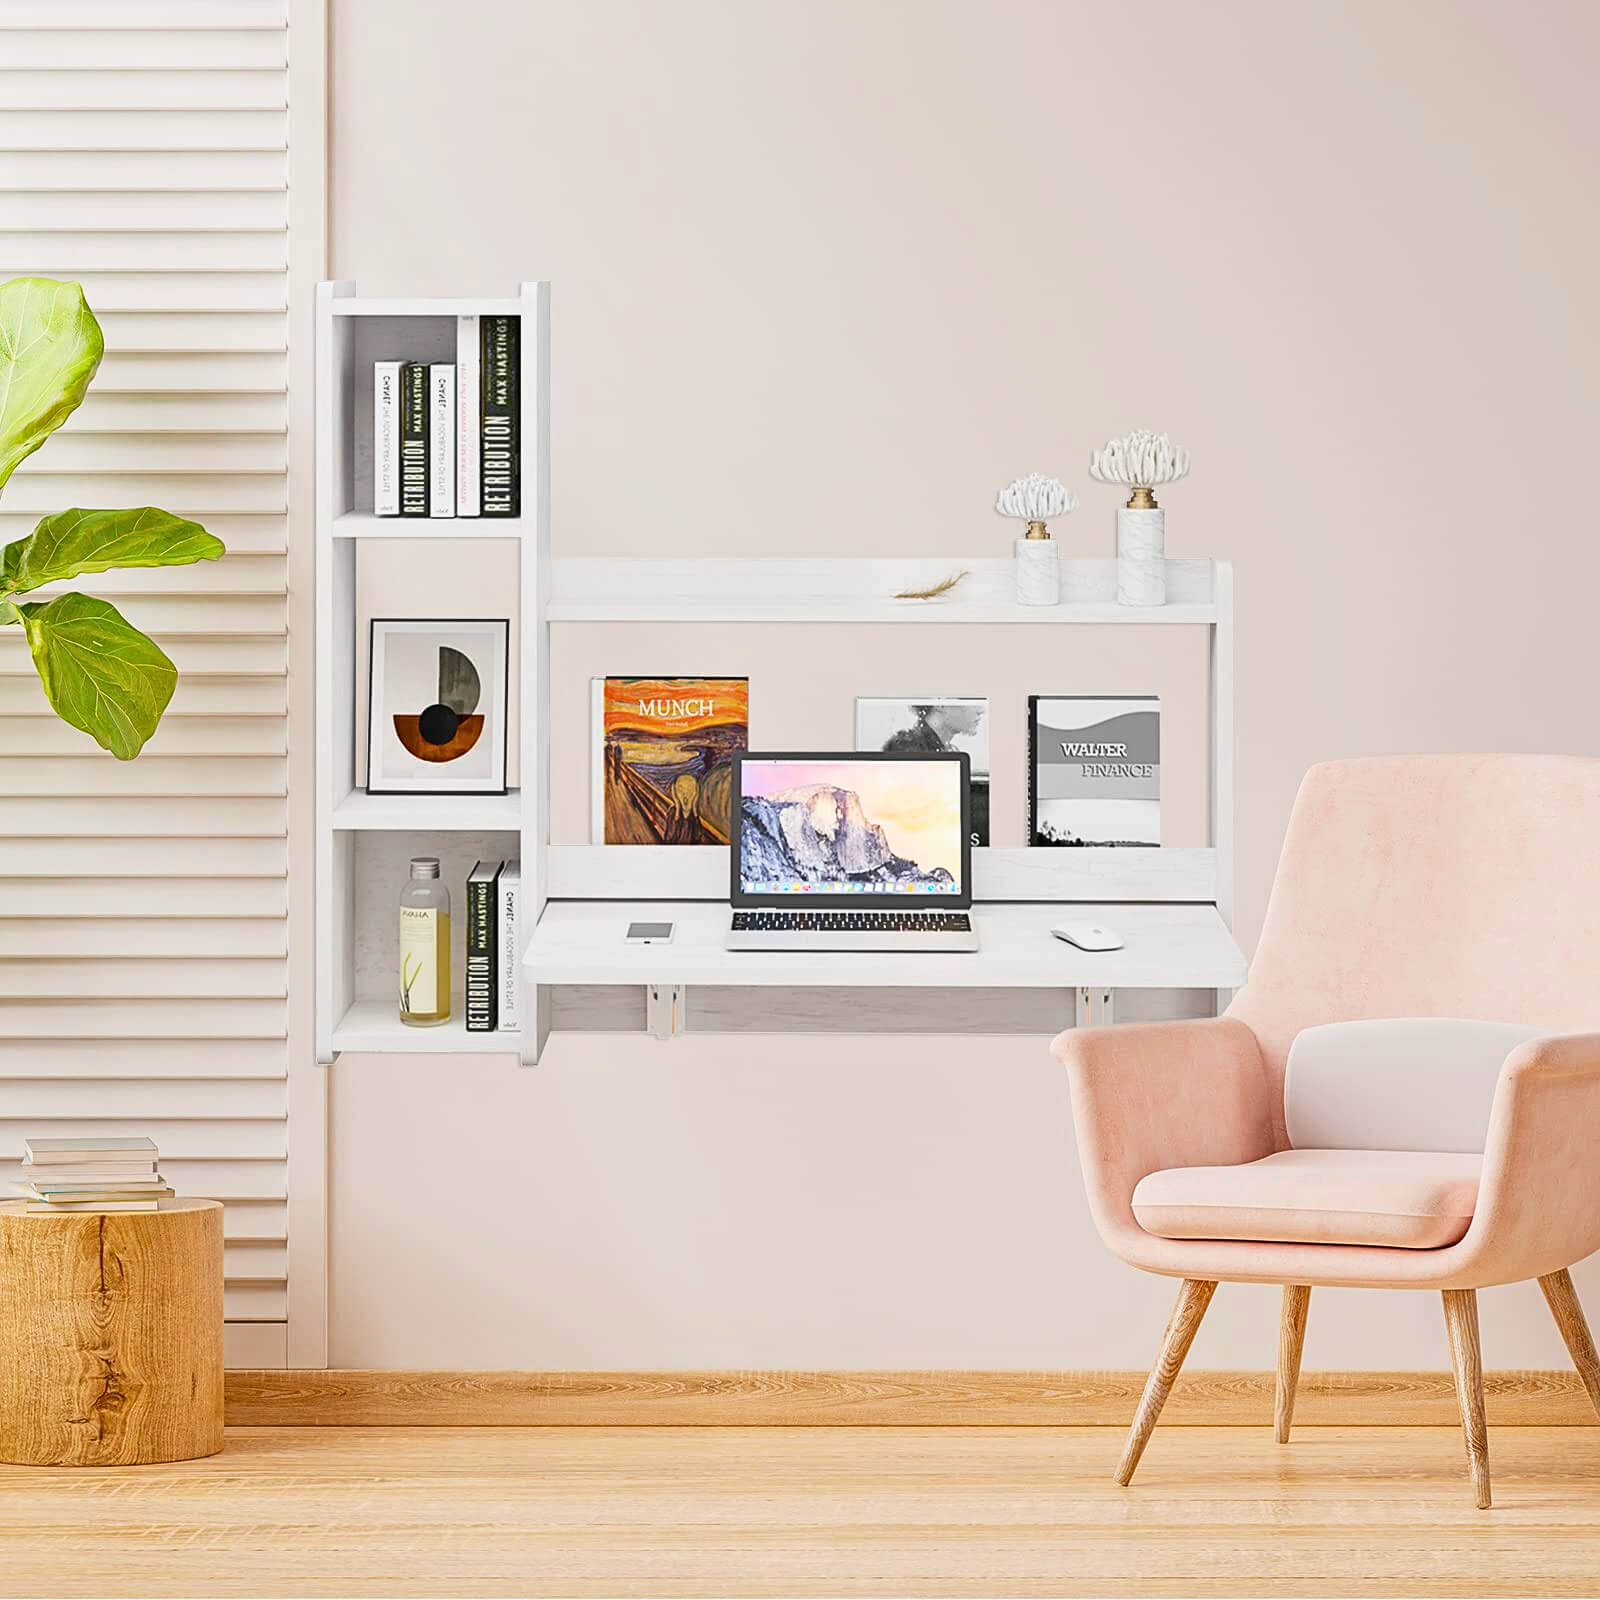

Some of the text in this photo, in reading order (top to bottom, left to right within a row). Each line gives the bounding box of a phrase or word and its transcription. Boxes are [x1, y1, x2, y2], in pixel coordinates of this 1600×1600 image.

[495, 319, 508, 405] MAX HASTINGS
[413, 367, 423, 432] MAX HASTINGS
[403, 440, 425, 513] RETRIBUTION
[483, 415, 511, 512] RETRIBUTION
[639, 699, 714, 717] MUNCH
[1060, 743, 1128, 758] WALTER
[1081, 763, 1153, 778] FINANCE
[477, 883, 487, 949] MAX HASTINGS
[468, 956, 489, 1029] RETRIBUTION
